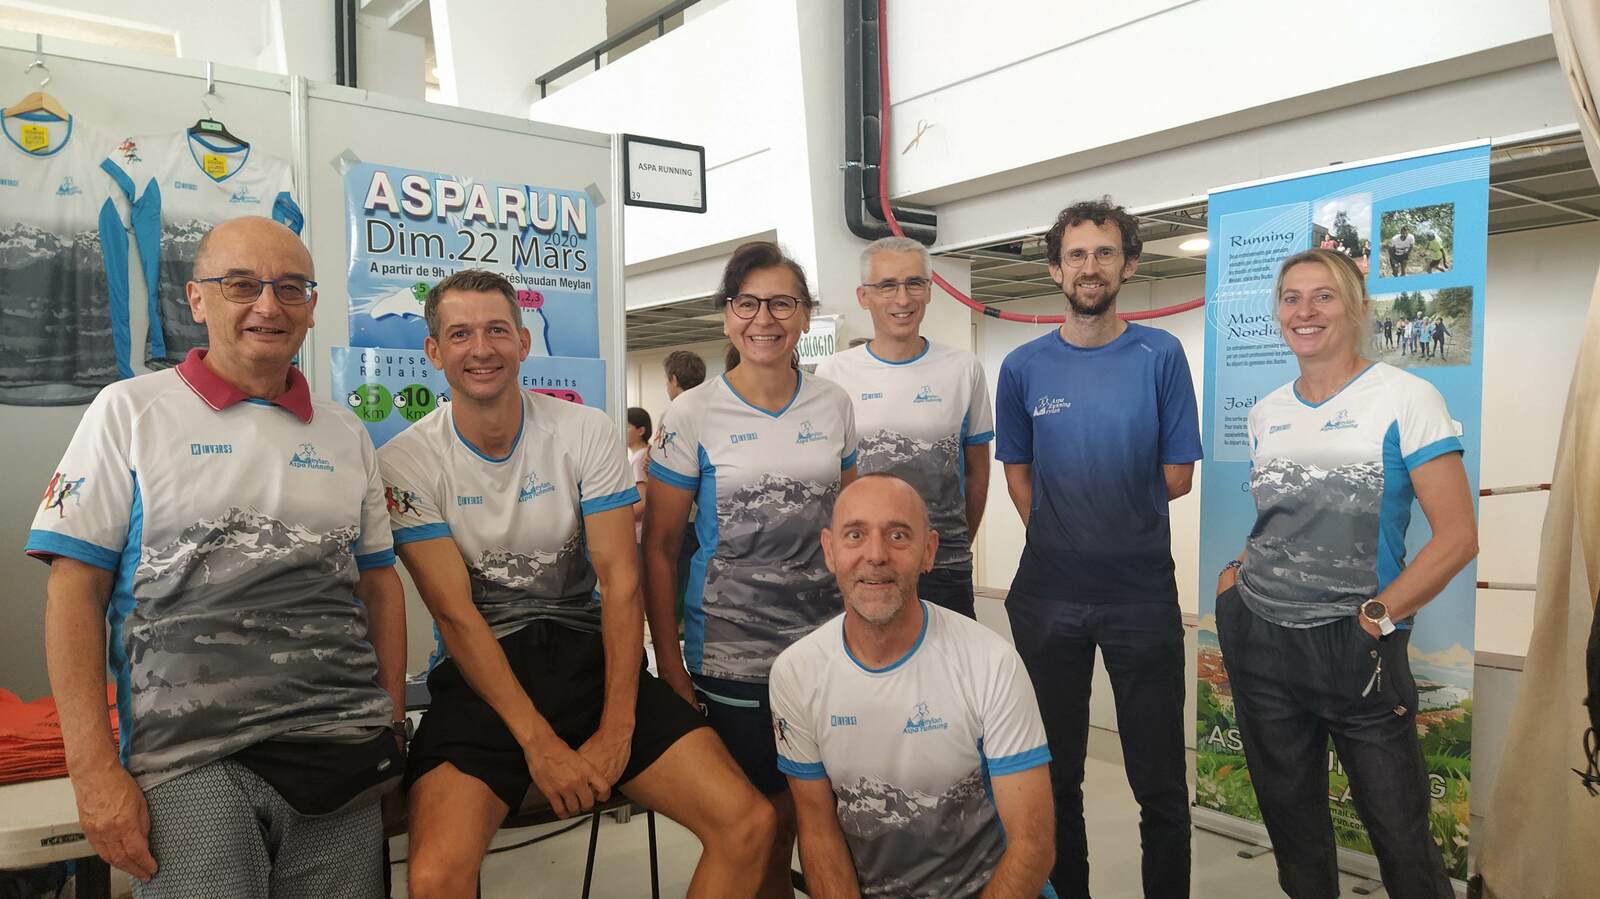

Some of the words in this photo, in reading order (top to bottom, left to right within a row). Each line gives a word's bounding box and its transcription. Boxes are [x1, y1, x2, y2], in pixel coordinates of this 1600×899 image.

[638, 162, 657, 172] ASPA
[658, 165, 693, 177] RUNNING
[631, 191, 641, 200] 39
[363, 171, 588, 238] ASPARUN
[544, 232, 579, 249] 2020
[1230, 231, 1295, 247] Running
[511, 234, 588, 272] Mars
[370, 262, 379, 273] A
[381, 263, 414, 278] partir
[416, 266, 430, 277] de
[559, 276, 592, 291] Meylan
[360, 353, 426, 366] Course
[360, 365, 428, 378] Relais
[523, 375, 577, 387] Enfants
[366, 386, 381, 406] 5
[403, 387, 430, 407] 10
[363, 408, 385, 420] km
[406, 407, 426, 420] km
